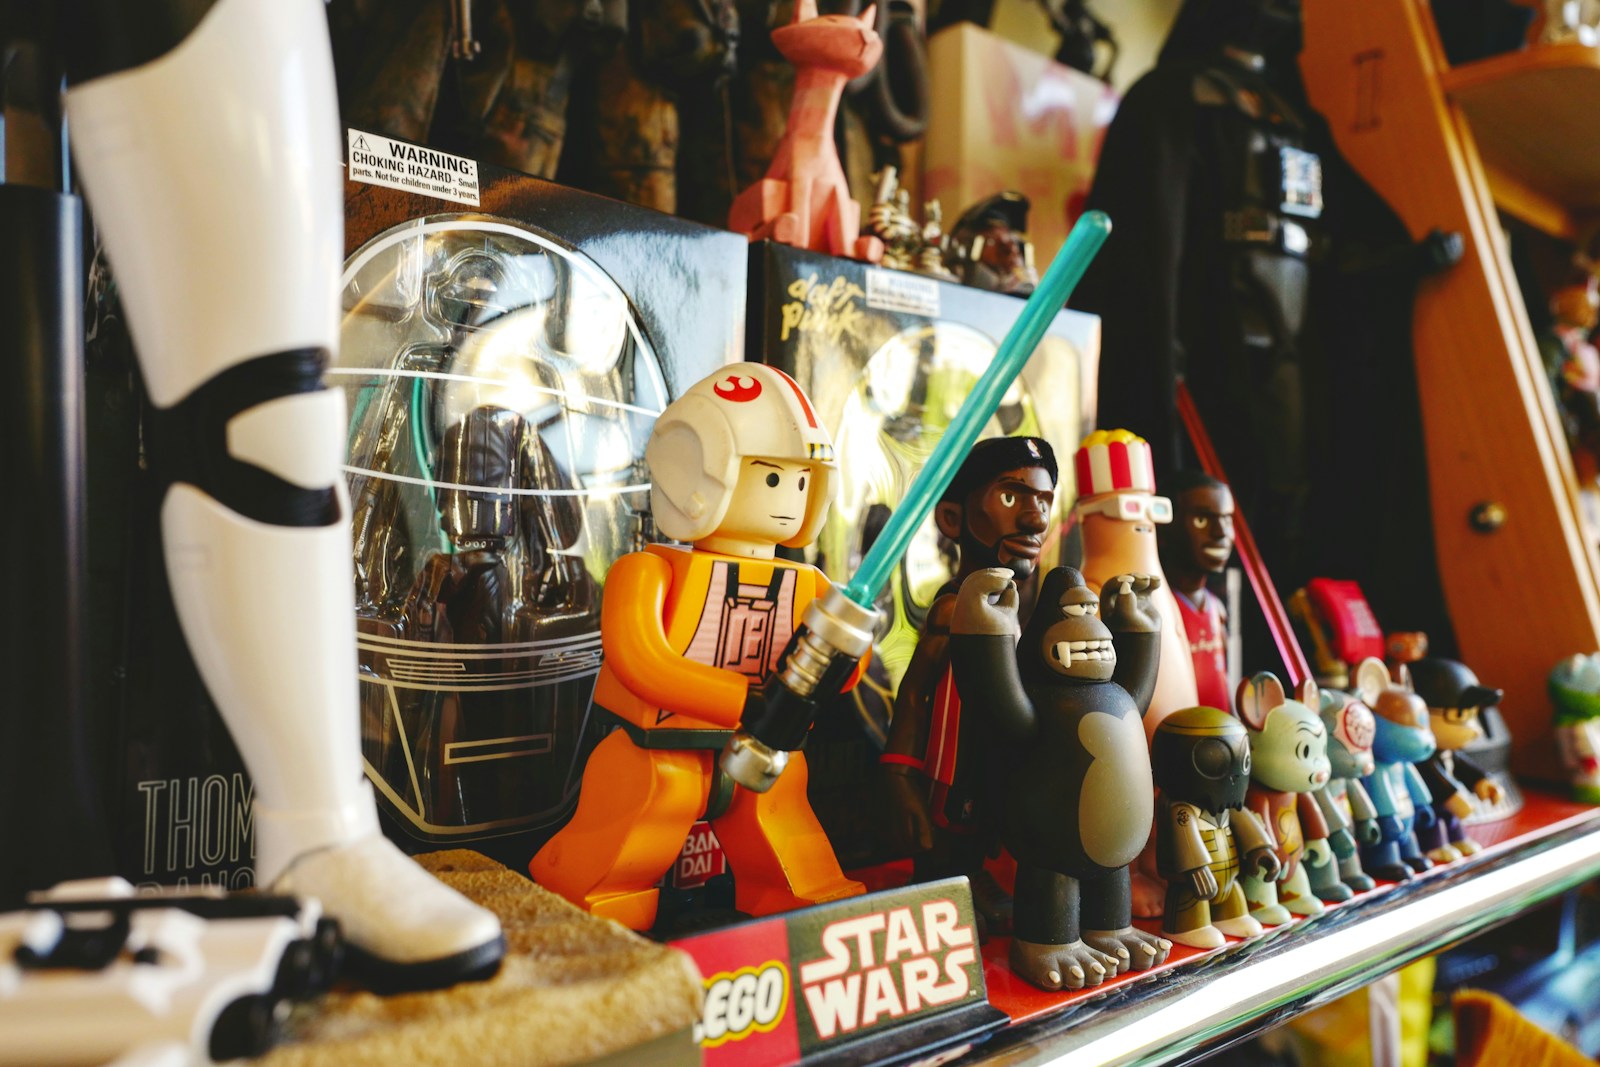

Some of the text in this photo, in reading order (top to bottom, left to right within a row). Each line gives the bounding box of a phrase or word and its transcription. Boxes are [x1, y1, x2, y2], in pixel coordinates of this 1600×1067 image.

[353, 151, 404, 173] CHOKING
[458, 178, 478, 190] Small
[353, 167, 478, 201] parts. Not for children under 3 years.
[389, 142, 473, 176] WARNING:
[138, 773, 257, 875] THOM
[681, 852, 712, 879] DAI
[800, 900, 973, 984] STAR
[692, 967, 784, 1044] EGO
[803, 947, 975, 1039] WARS
